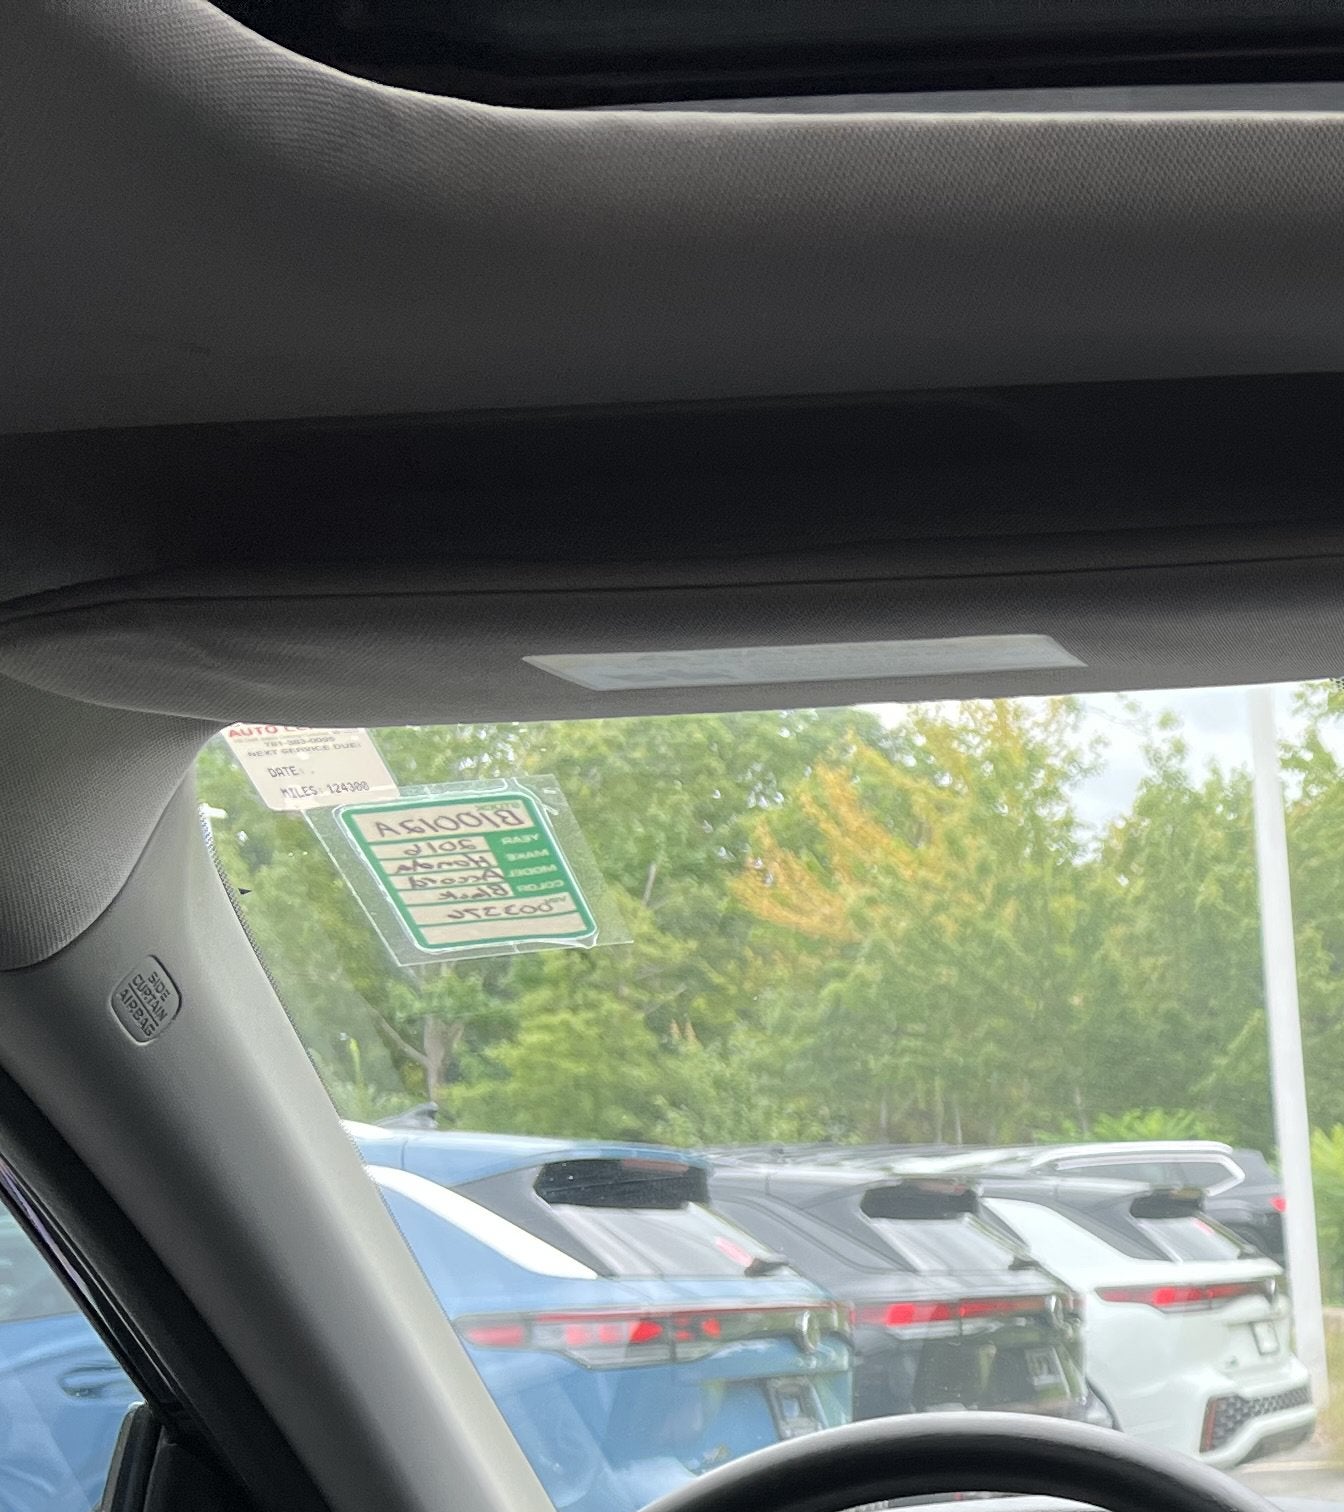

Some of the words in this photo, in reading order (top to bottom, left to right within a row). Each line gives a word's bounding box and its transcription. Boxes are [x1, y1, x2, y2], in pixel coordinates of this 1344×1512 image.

[228, 724, 278, 738] AUTO
[248, 749, 278, 757] NEXT
[120, 988, 156, 1037] AIRBAG
[132, 973, 168, 1022] CURTAIN
